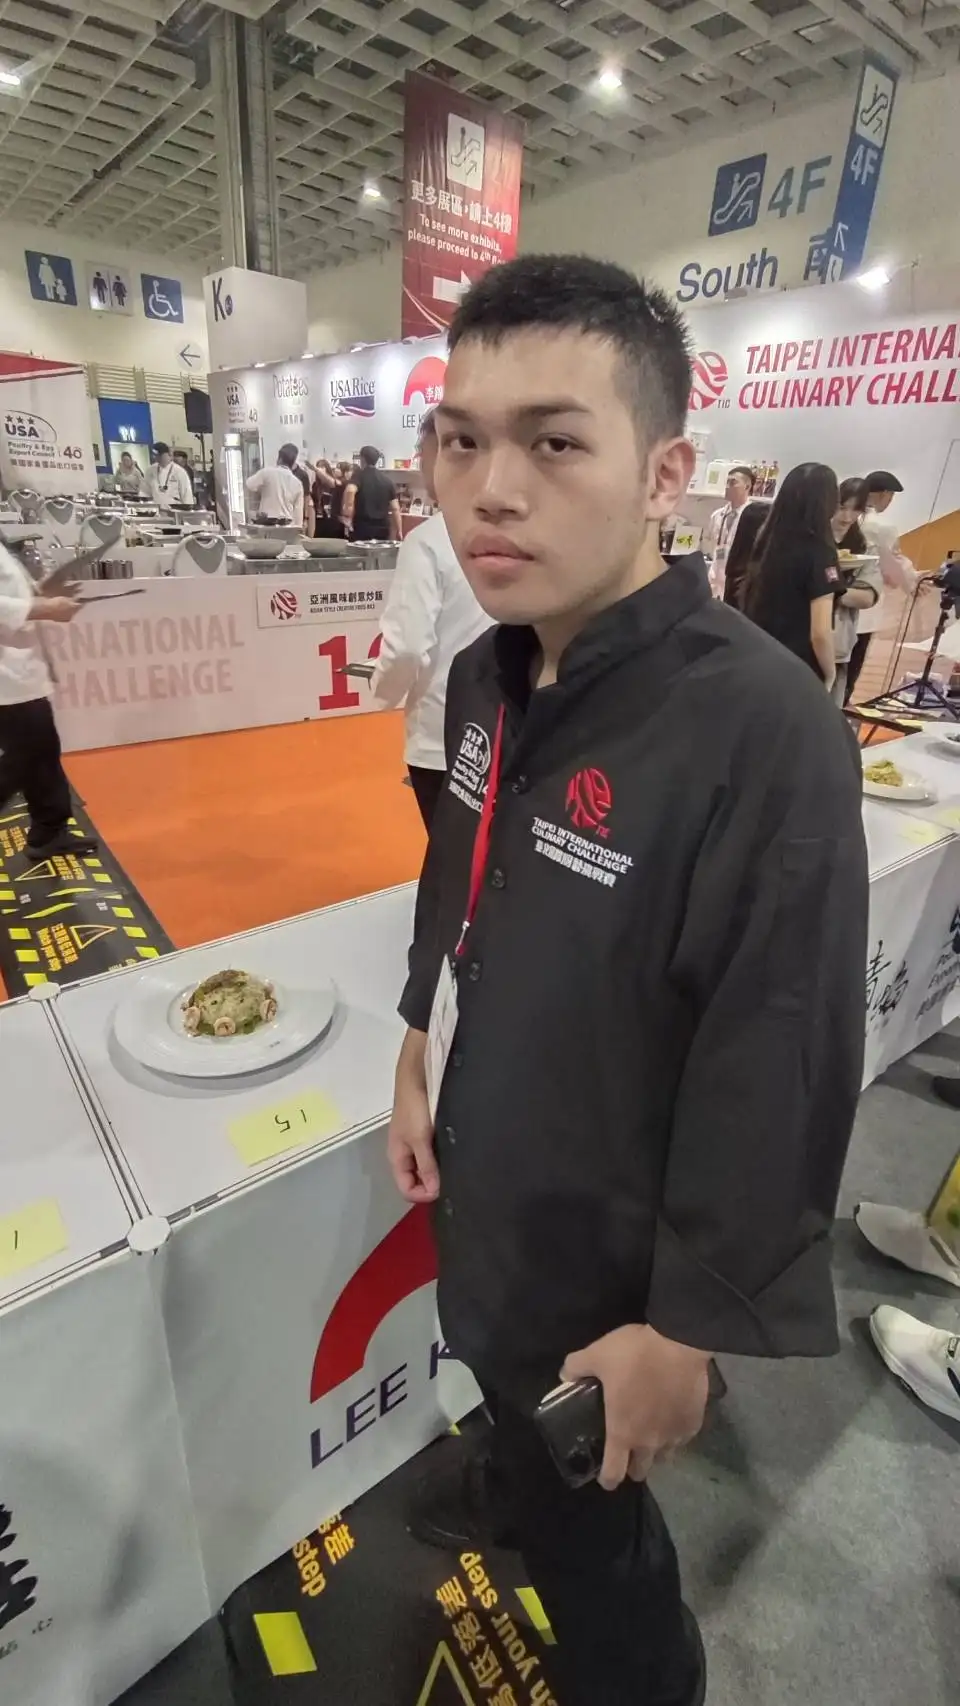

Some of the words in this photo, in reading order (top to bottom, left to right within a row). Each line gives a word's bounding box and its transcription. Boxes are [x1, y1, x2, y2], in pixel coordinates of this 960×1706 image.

[767, 155, 832, 218] 4F
[851, 144, 879, 185] 4F
[408, 228, 436, 246] please
[437, 239, 469, 256] proceed
[419, 213, 430, 228] To
[432, 219, 446, 232] see
[448, 226, 469, 240] more
[676, 248, 778, 302] South
[746, 337, 823, 375] TAIPEI
[826, 323, 960, 369] INTERNA
[227, 395, 240, 406] USA
[738, 374, 864, 409] CULINARY
[866, 367, 960, 406] CHALL
[5, 423, 39, 438] USA
[402, 414, 416, 428] LEE
[460, 740, 479, 762] USA
[532, 826, 567, 847] CULINARY
[568, 842, 628, 874] CHALLENGE
[533, 816, 556, 834] TAIPEI
[557, 828, 634, 867] INTERNATIONAL
[310, 1362, 408, 1470] LEE
[292, 1538, 326, 1597] step
[460, 1552, 498, 1609] step
[490, 1612, 540, 1683] your
